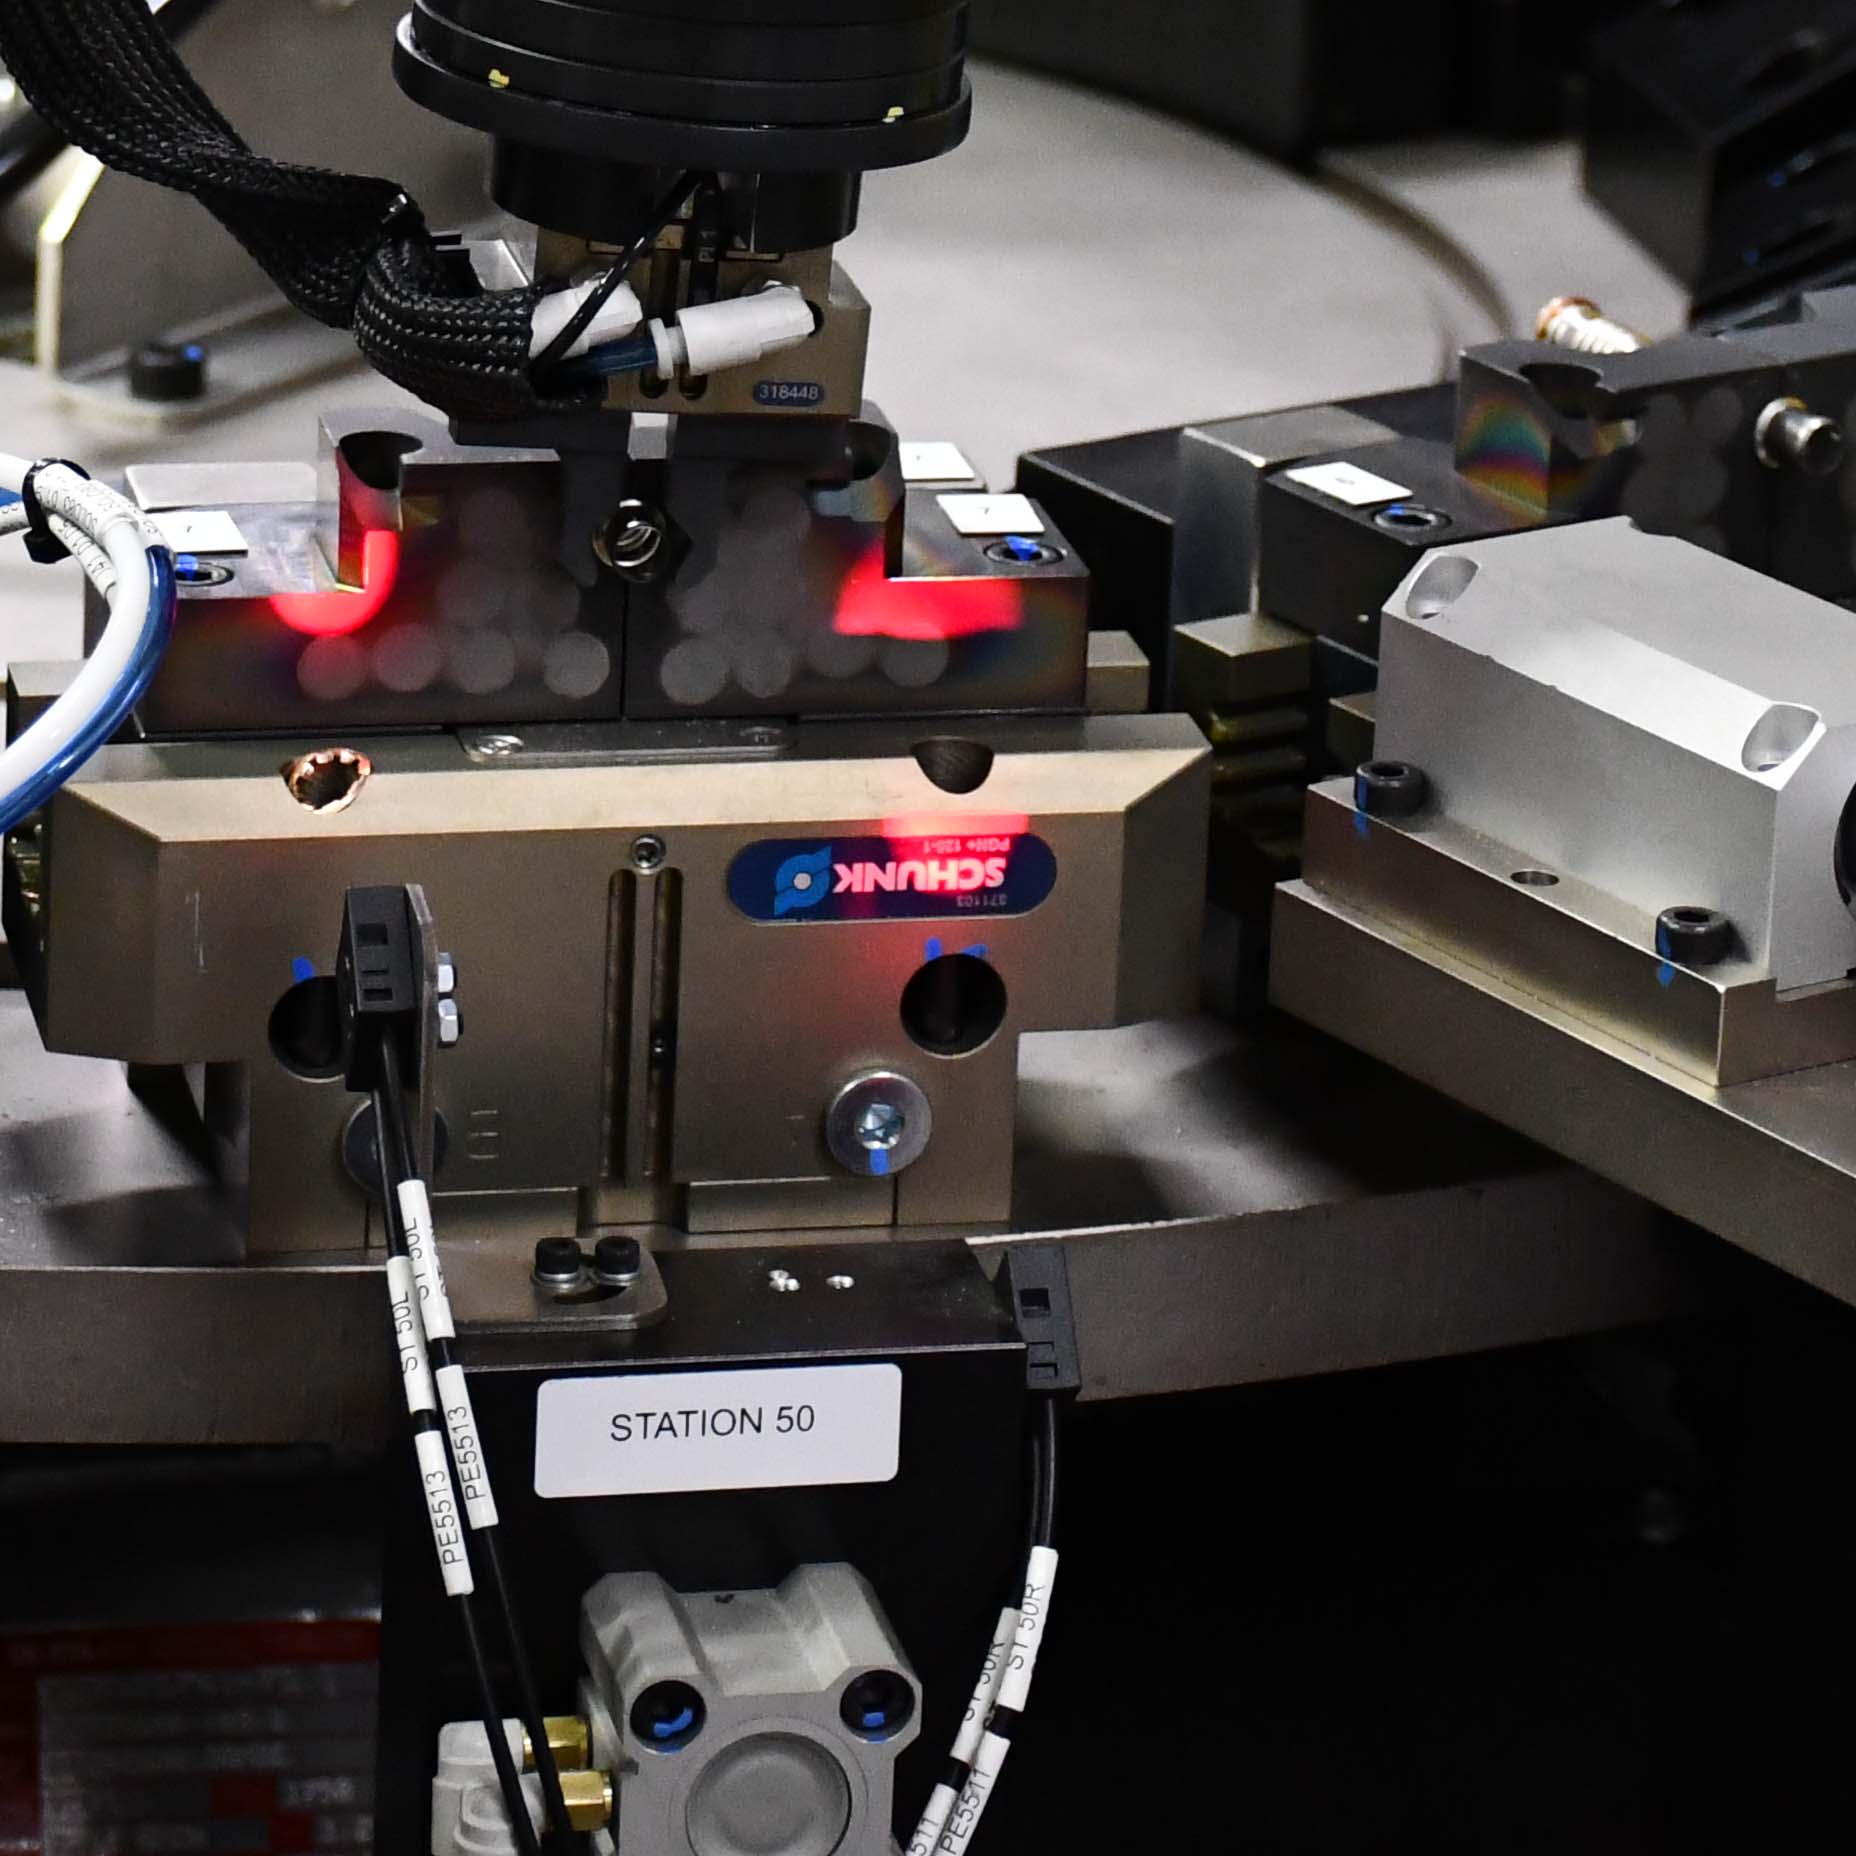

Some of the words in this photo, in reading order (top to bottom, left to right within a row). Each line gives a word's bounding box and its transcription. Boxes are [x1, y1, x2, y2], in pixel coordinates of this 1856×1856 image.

[759, 384, 819, 400] 318448
[832, 857, 1007, 894] SCHUNK
[610, 1408, 763, 1442] STATION
[776, 1404, 816, 1433] 50
[446, 1406, 486, 1501] PE5513
[424, 1470, 464, 1565] PE5513
[1016, 1583, 1046, 1632] 50R
